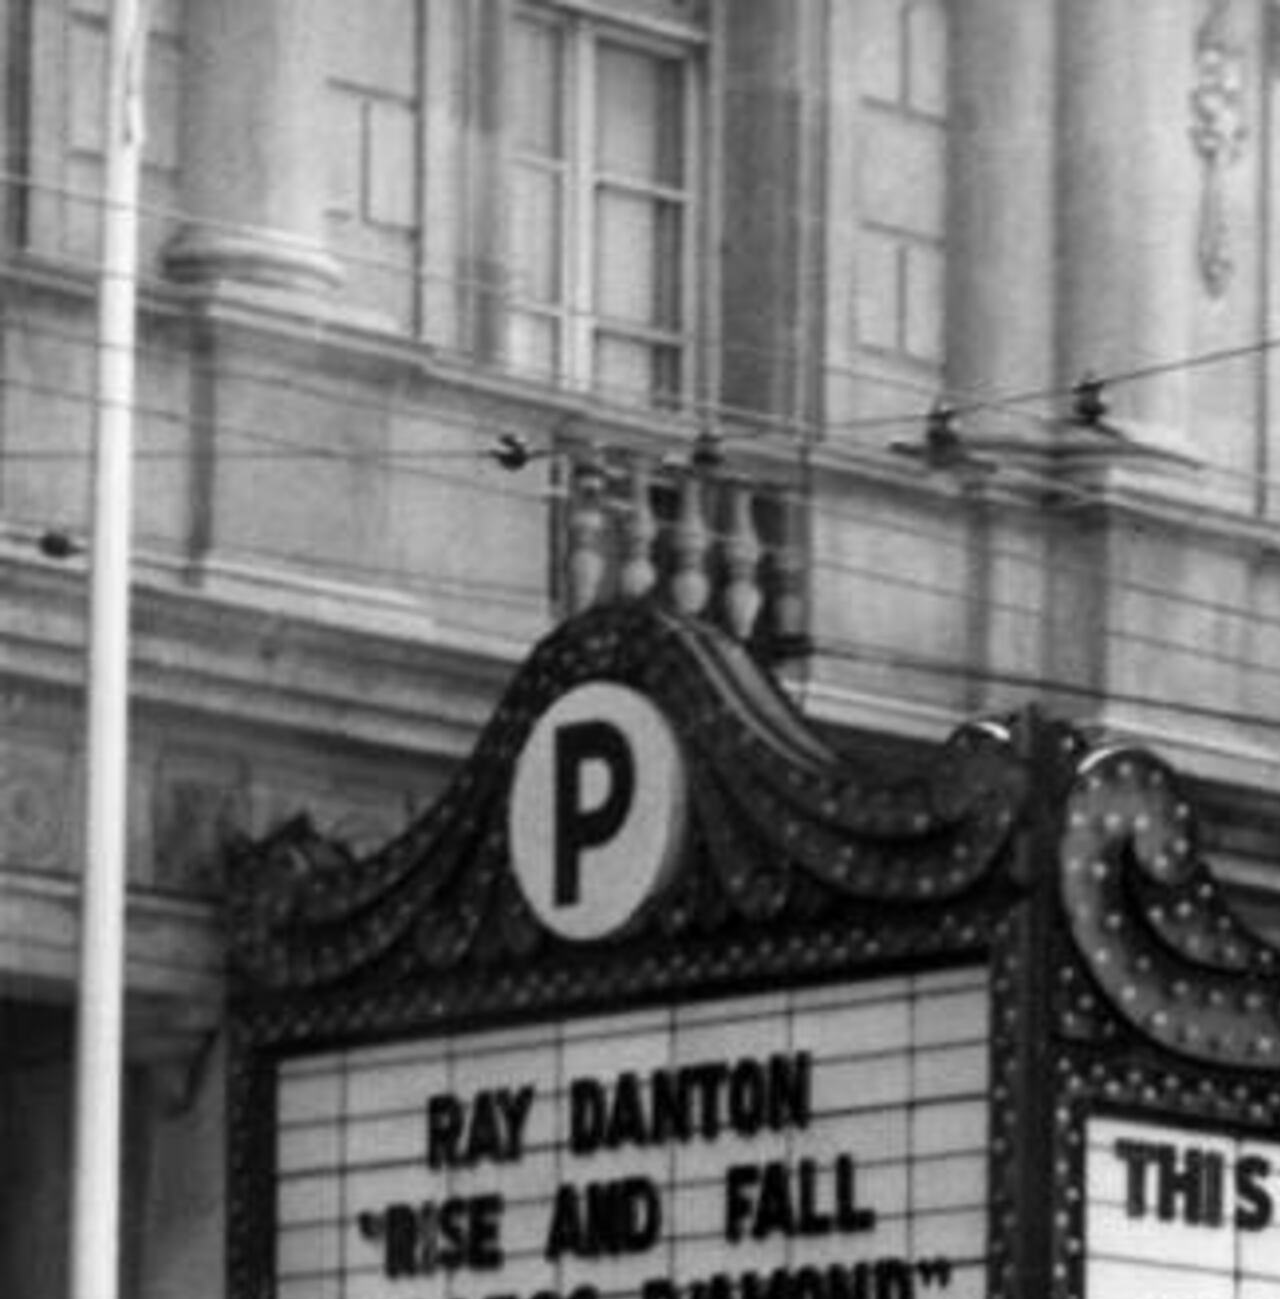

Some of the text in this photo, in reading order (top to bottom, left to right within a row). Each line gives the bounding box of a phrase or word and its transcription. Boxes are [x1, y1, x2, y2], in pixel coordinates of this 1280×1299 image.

[553, 720, 635, 908] P
[427, 1052, 812, 1169] RAY DANTON
[545, 1176, 661, 1260] AND
[724, 1154, 876, 1242] FALL
[1114, 1138, 1273, 1231] THIS
